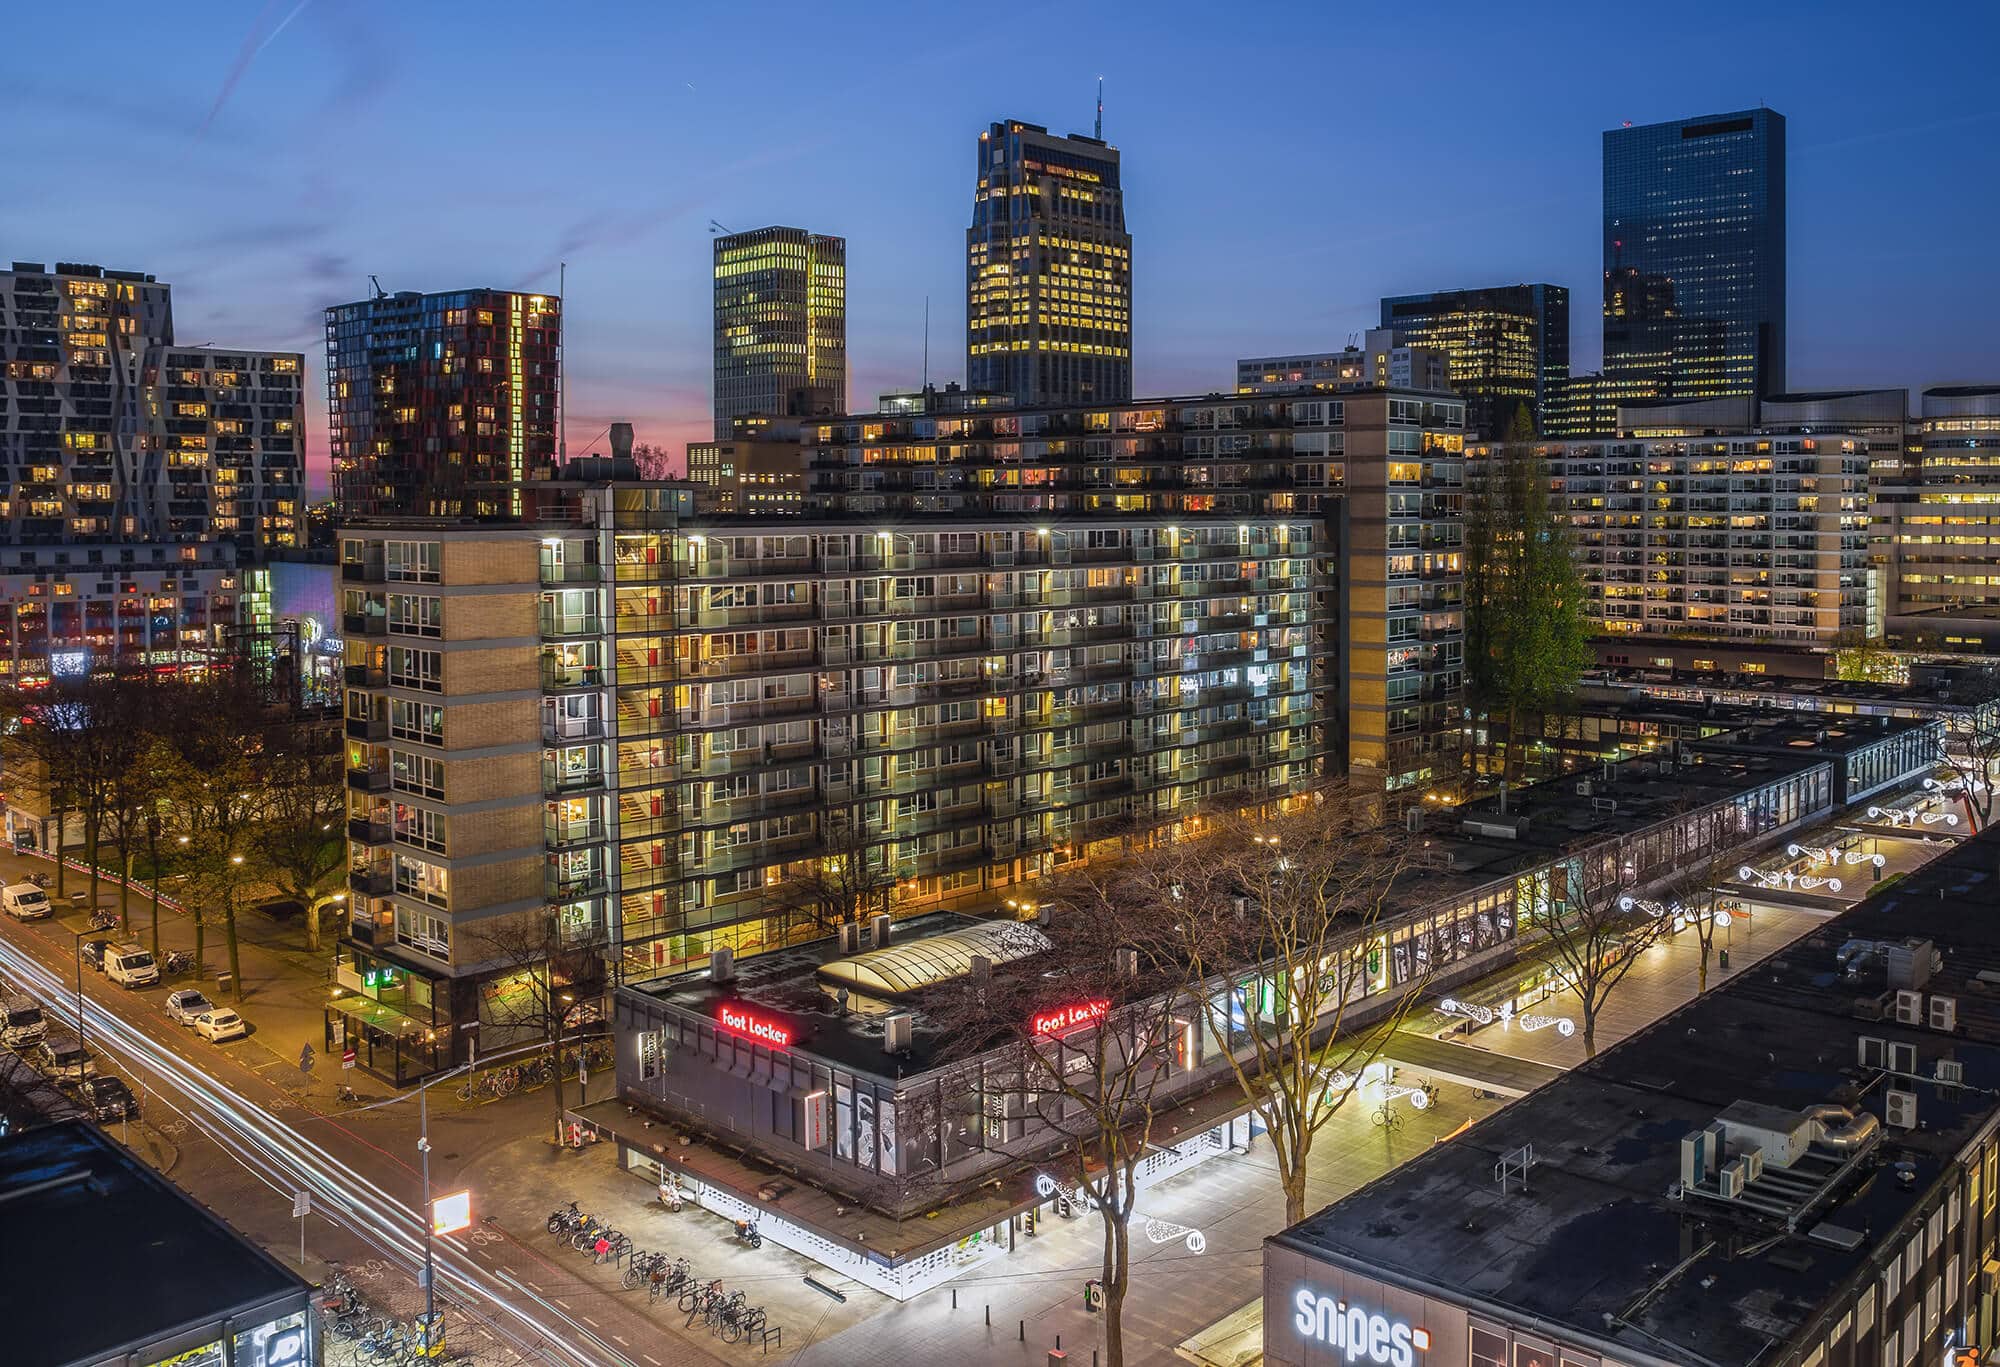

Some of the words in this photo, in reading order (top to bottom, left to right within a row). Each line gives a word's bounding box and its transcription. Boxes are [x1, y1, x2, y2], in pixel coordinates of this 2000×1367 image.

[722, 1008, 747, 1031] Foot
[749, 1017, 788, 1045] Locker
[1296, 1289, 1413, 1367] snipes
[268, 1335, 301, 1365] JD
